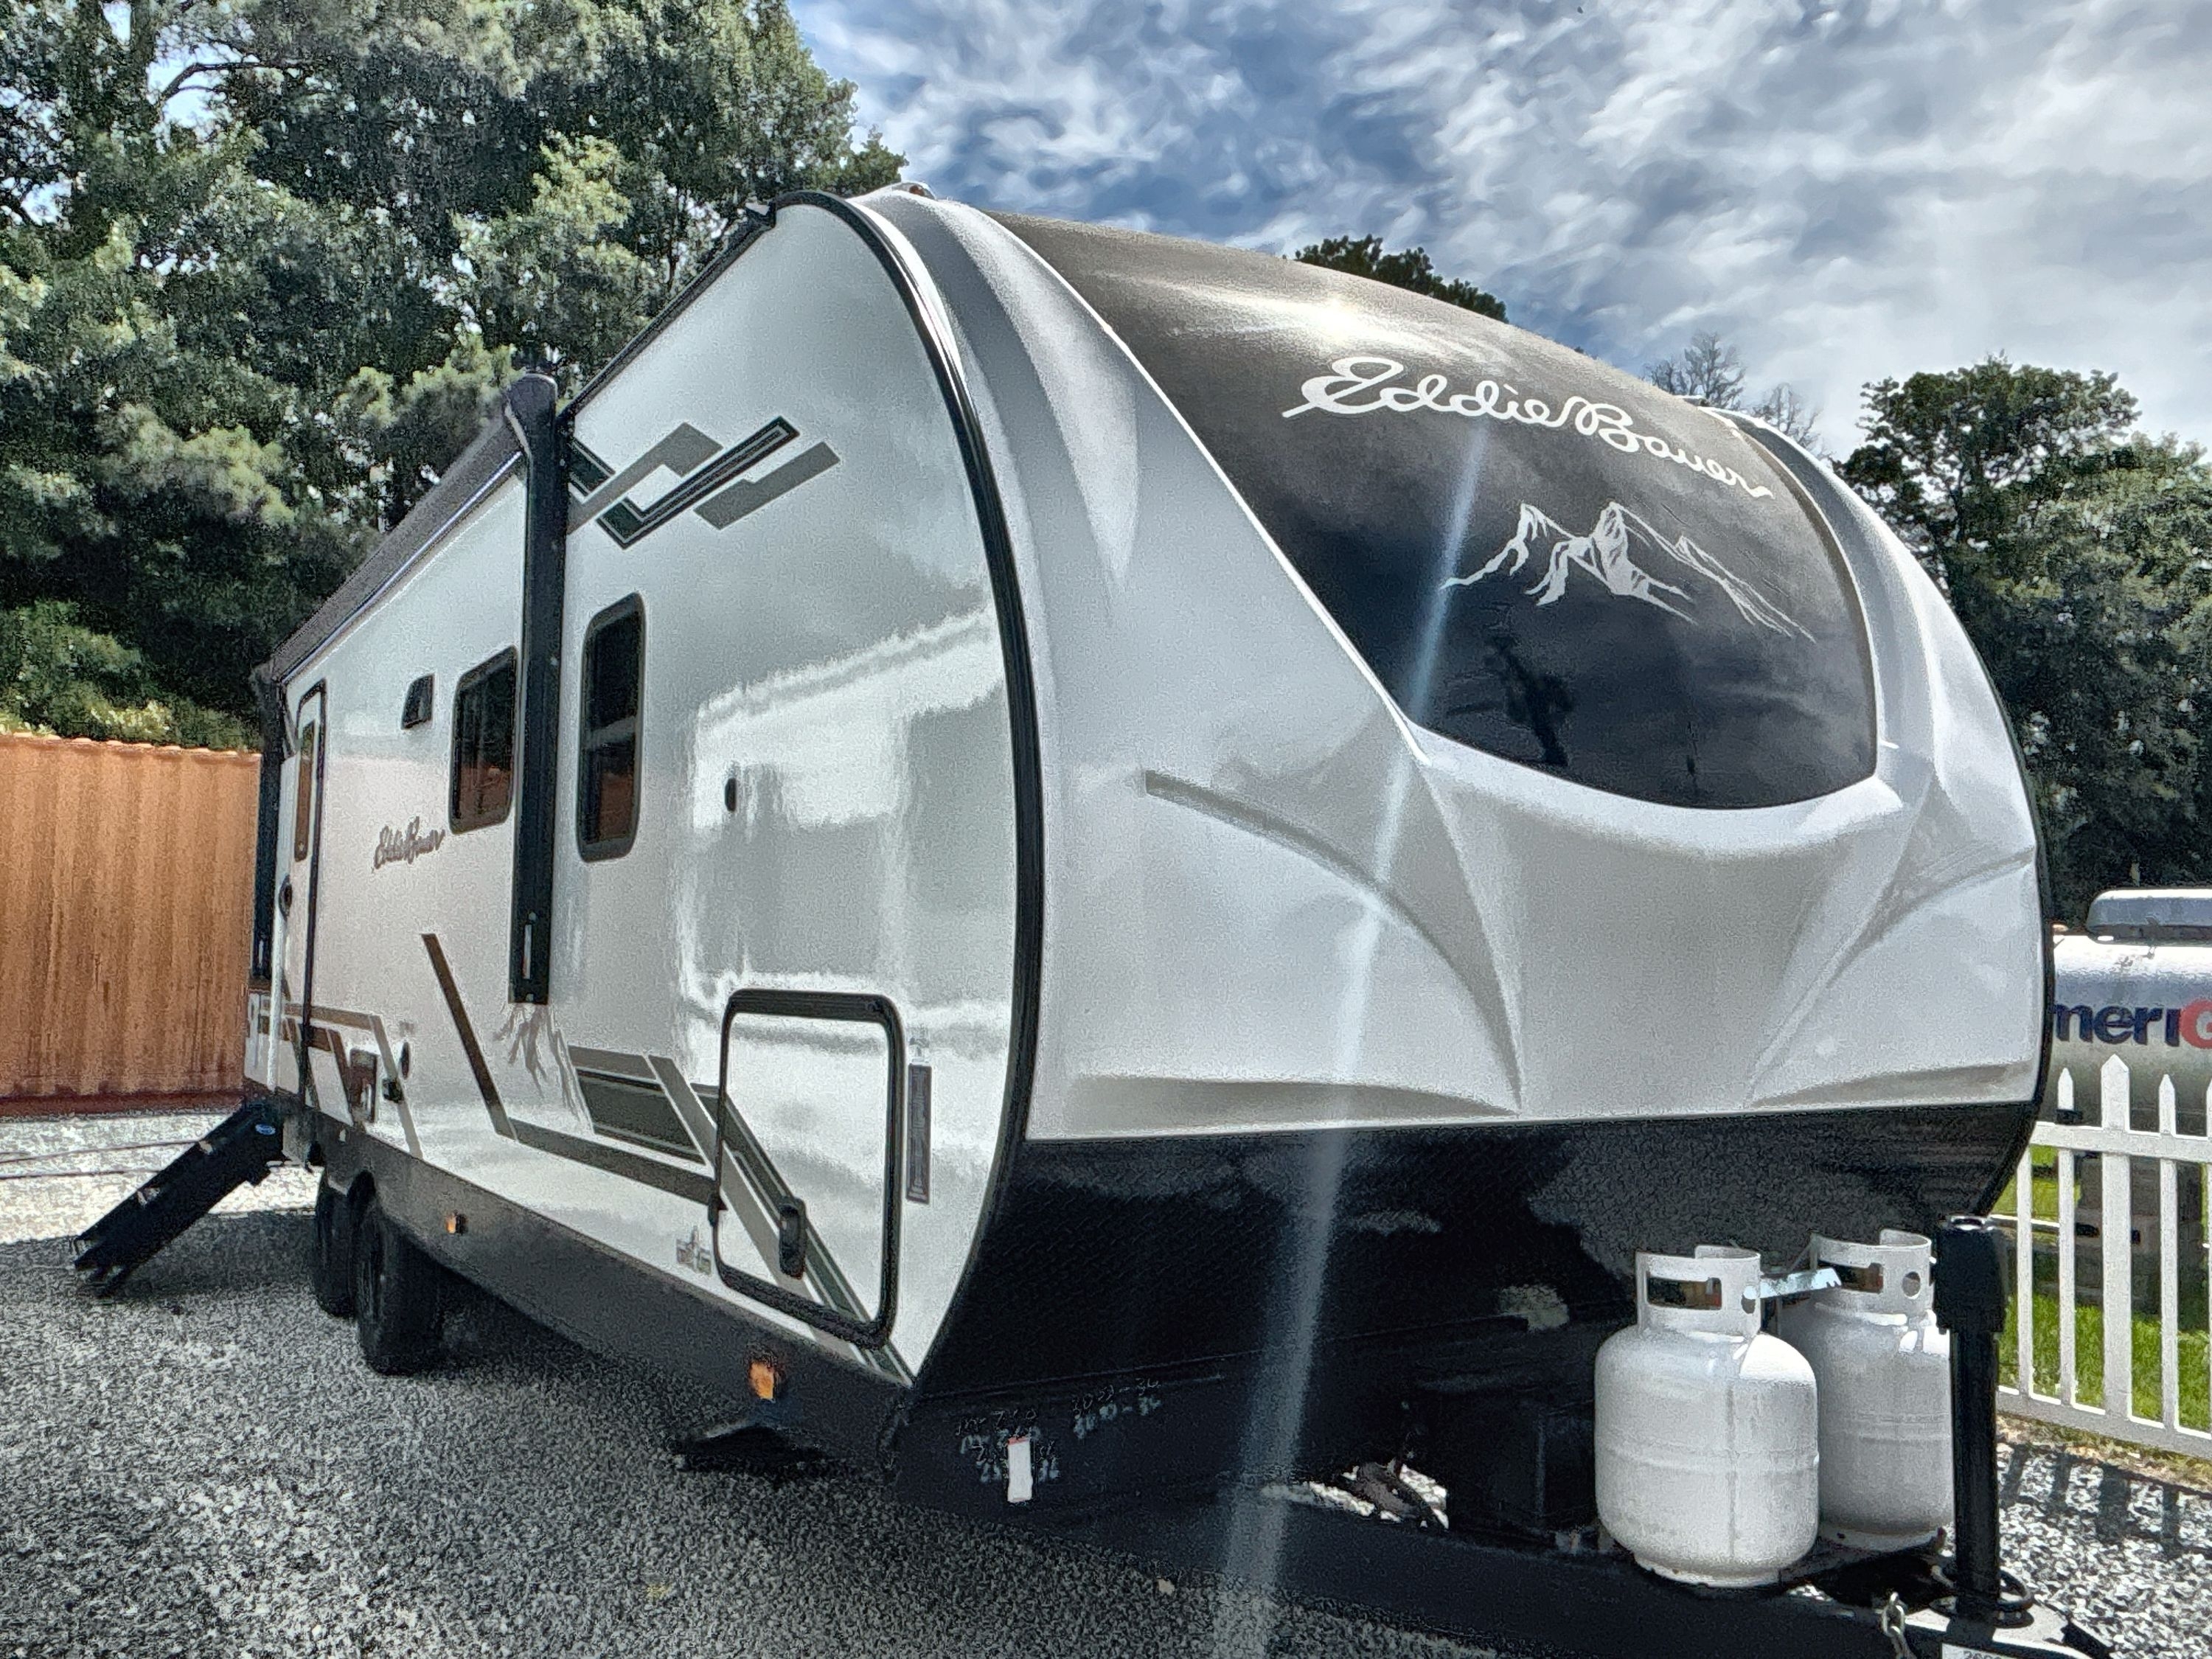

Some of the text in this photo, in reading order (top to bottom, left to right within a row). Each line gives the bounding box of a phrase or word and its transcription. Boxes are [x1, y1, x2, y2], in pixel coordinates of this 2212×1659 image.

[1281, 356, 1774, 498] Eddie Bauer
[2052, 998, 2212, 1049] meriG
